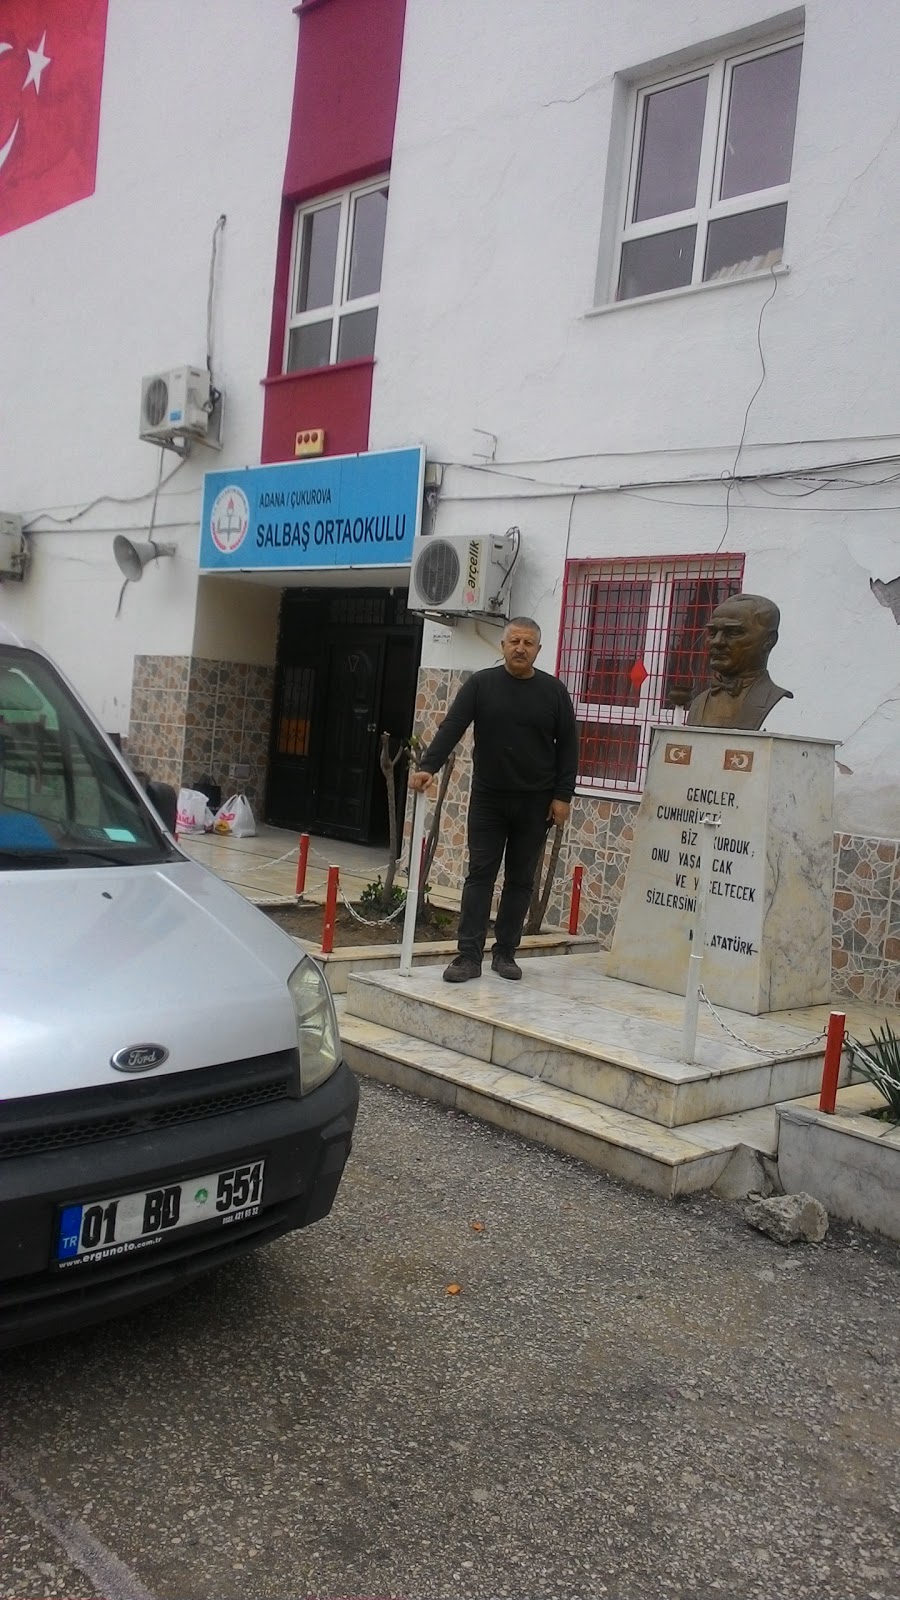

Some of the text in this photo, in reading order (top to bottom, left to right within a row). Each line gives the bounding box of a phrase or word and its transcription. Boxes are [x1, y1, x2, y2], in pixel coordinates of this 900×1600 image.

[259, 492, 285, 508] ADANA
[290, 488, 332, 510] ÇUKUROVA
[256, 514, 406, 552] SALBAŞ ORTAOKULU
[467, 540, 480, 589] arçelik
[686, 787, 739, 809] GENÇLER,
[681, 828, 698, 846] BİZ
[651, 847, 670, 863] ONU
[675, 873, 687, 889] VE
[128, 1050, 156, 1066] Ford
[81, 1163, 262, 1249] 01 BD 551
[58, 1236, 162, 1269] www.ergunoto.com.tr
[62, 1236, 78, 1249] TR
